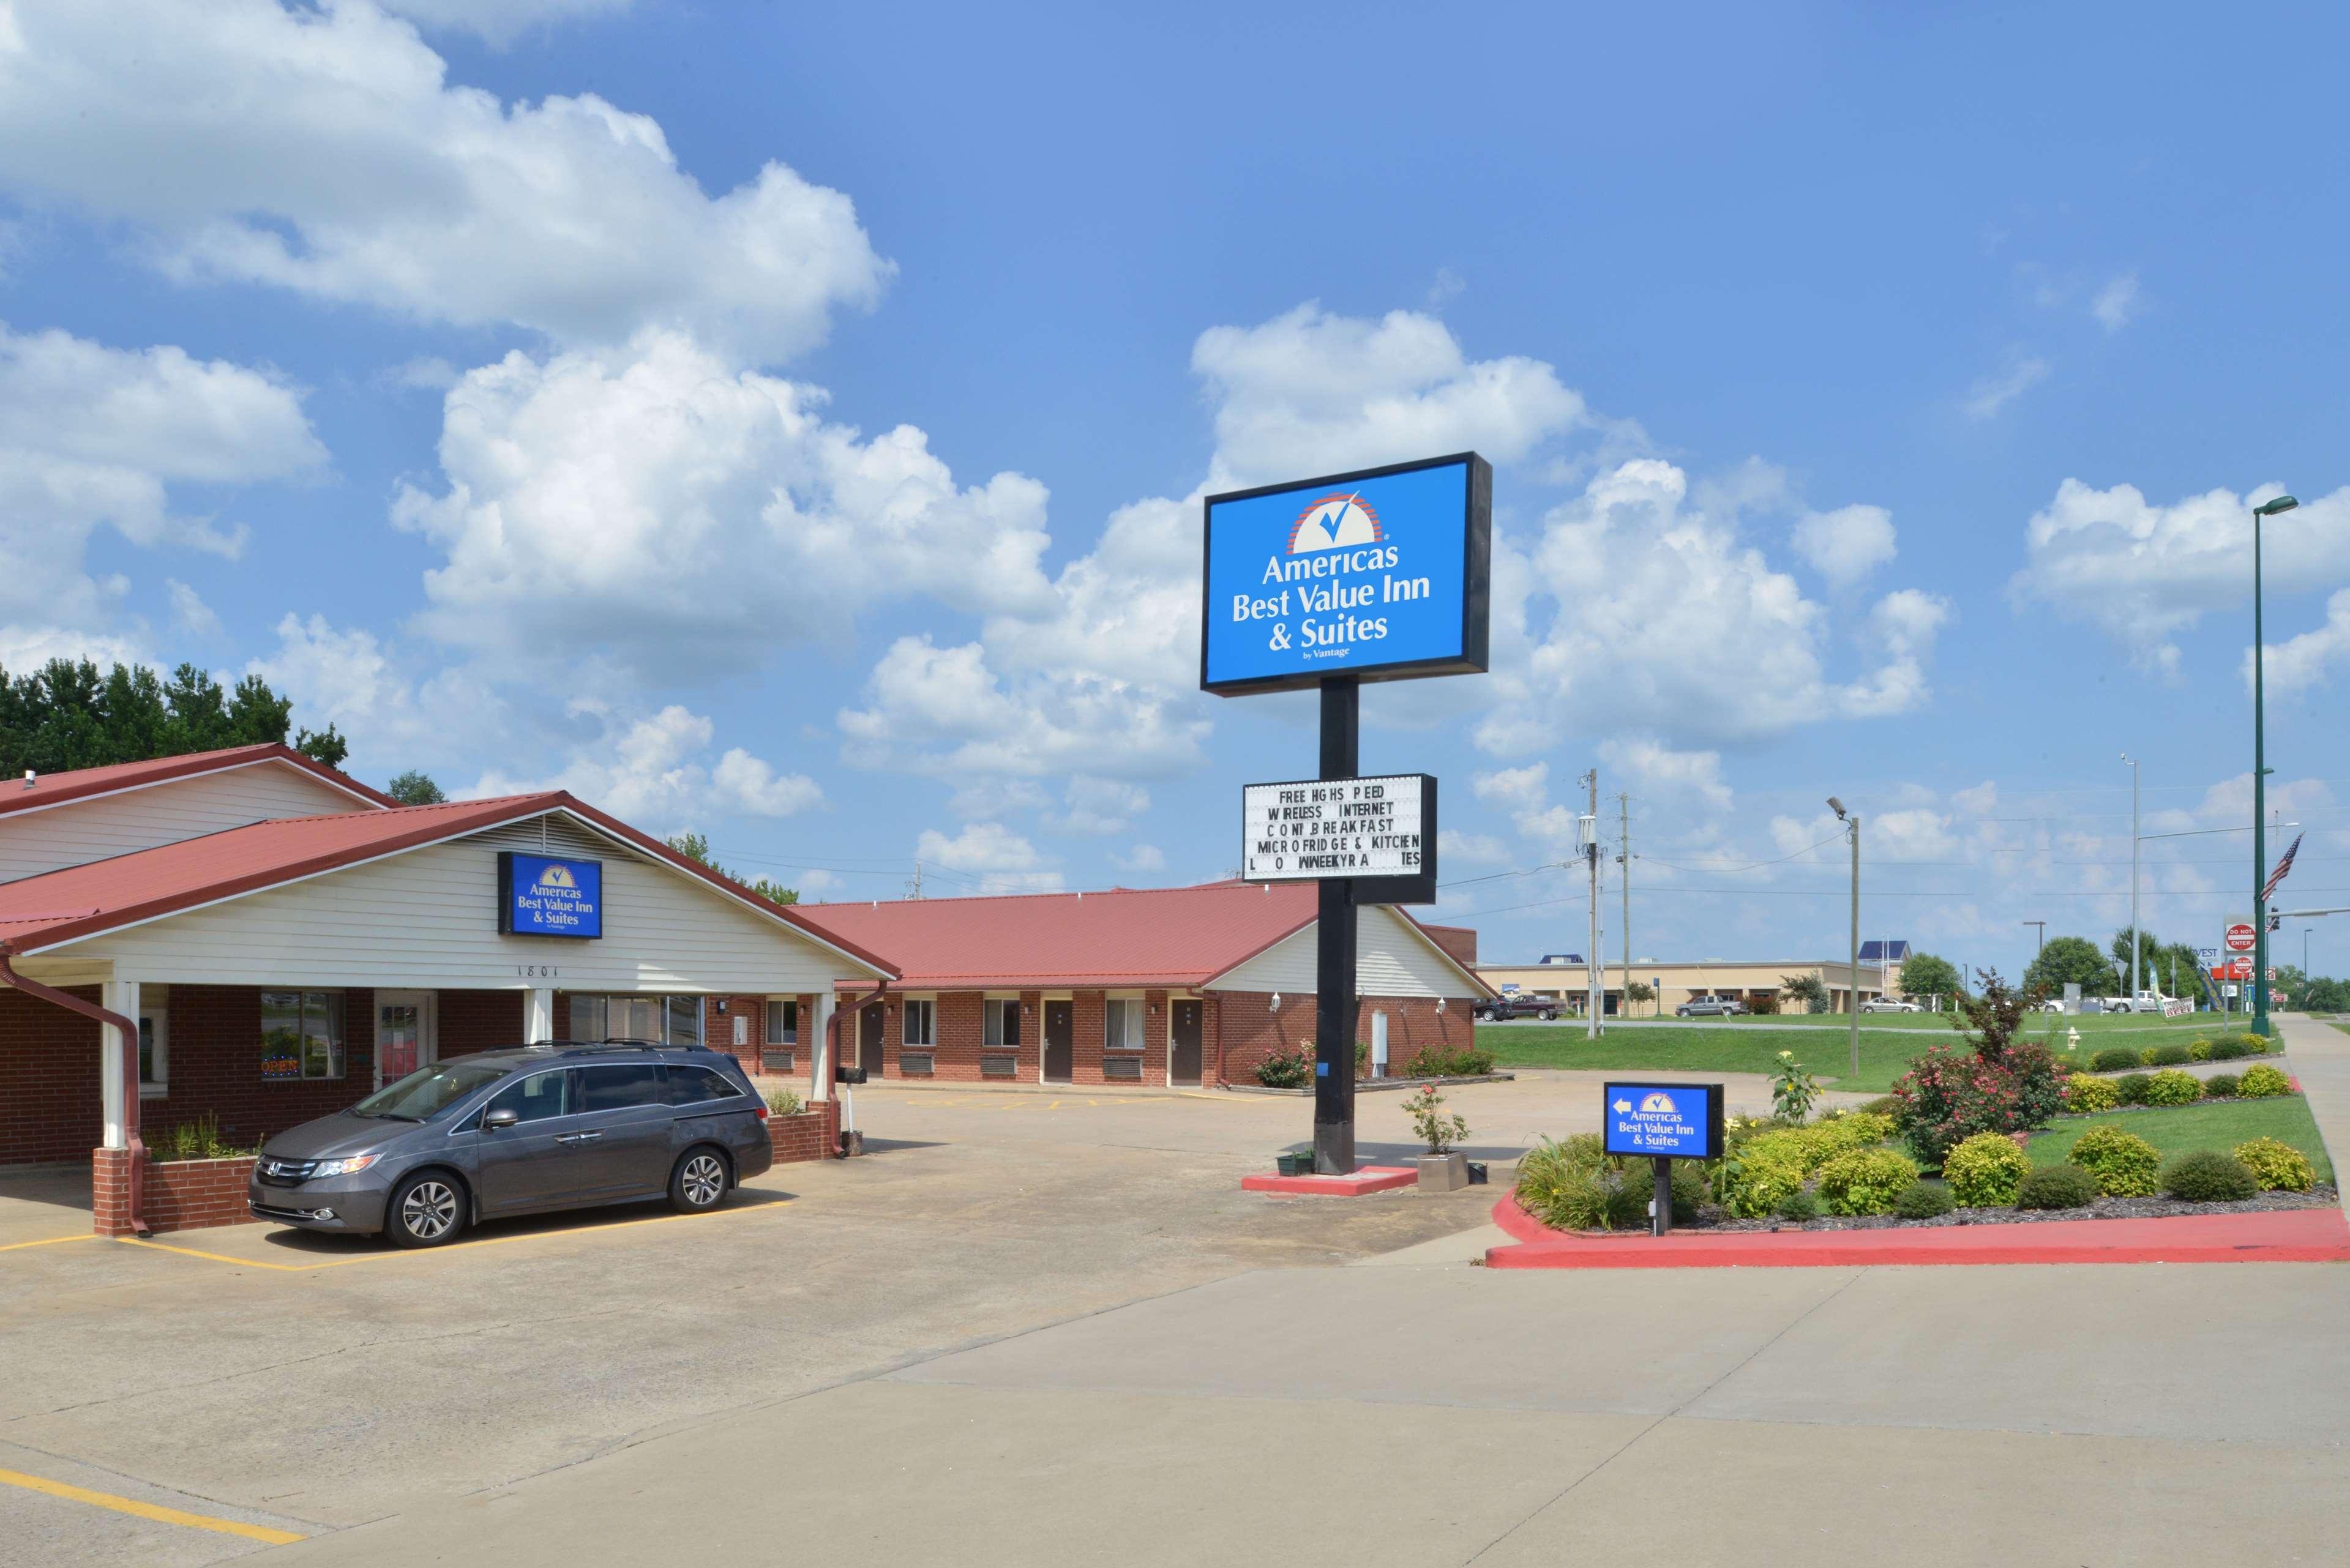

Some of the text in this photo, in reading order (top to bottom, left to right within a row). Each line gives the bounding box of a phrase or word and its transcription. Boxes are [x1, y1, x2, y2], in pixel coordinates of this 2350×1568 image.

[1262, 546, 1398, 584] Americas
[1233, 575, 1430, 622] Best Value Inn
[1269, 613, 1387, 651] & Suites
[1303, 648, 1350, 660] by Vantage
[1279, 790, 1306, 804] FREE
[1339, 802, 1394, 817] INTERNET
[1355, 837, 1362, 849] &
[1372, 834, 1420, 849] KITCHEN
[529, 883, 582, 899] Americas
[518, 896, 593, 913] Best Value Inn
[533, 911, 578, 925] & Suites
[518, 966, 558, 977] 1801
[261, 1060, 298, 1072] OPEN
[1631, 1110, 1683, 1122] Americas
[1618, 1121, 1694, 1135] Best Value Inn
[1633, 1134, 1679, 1146] & Suites
